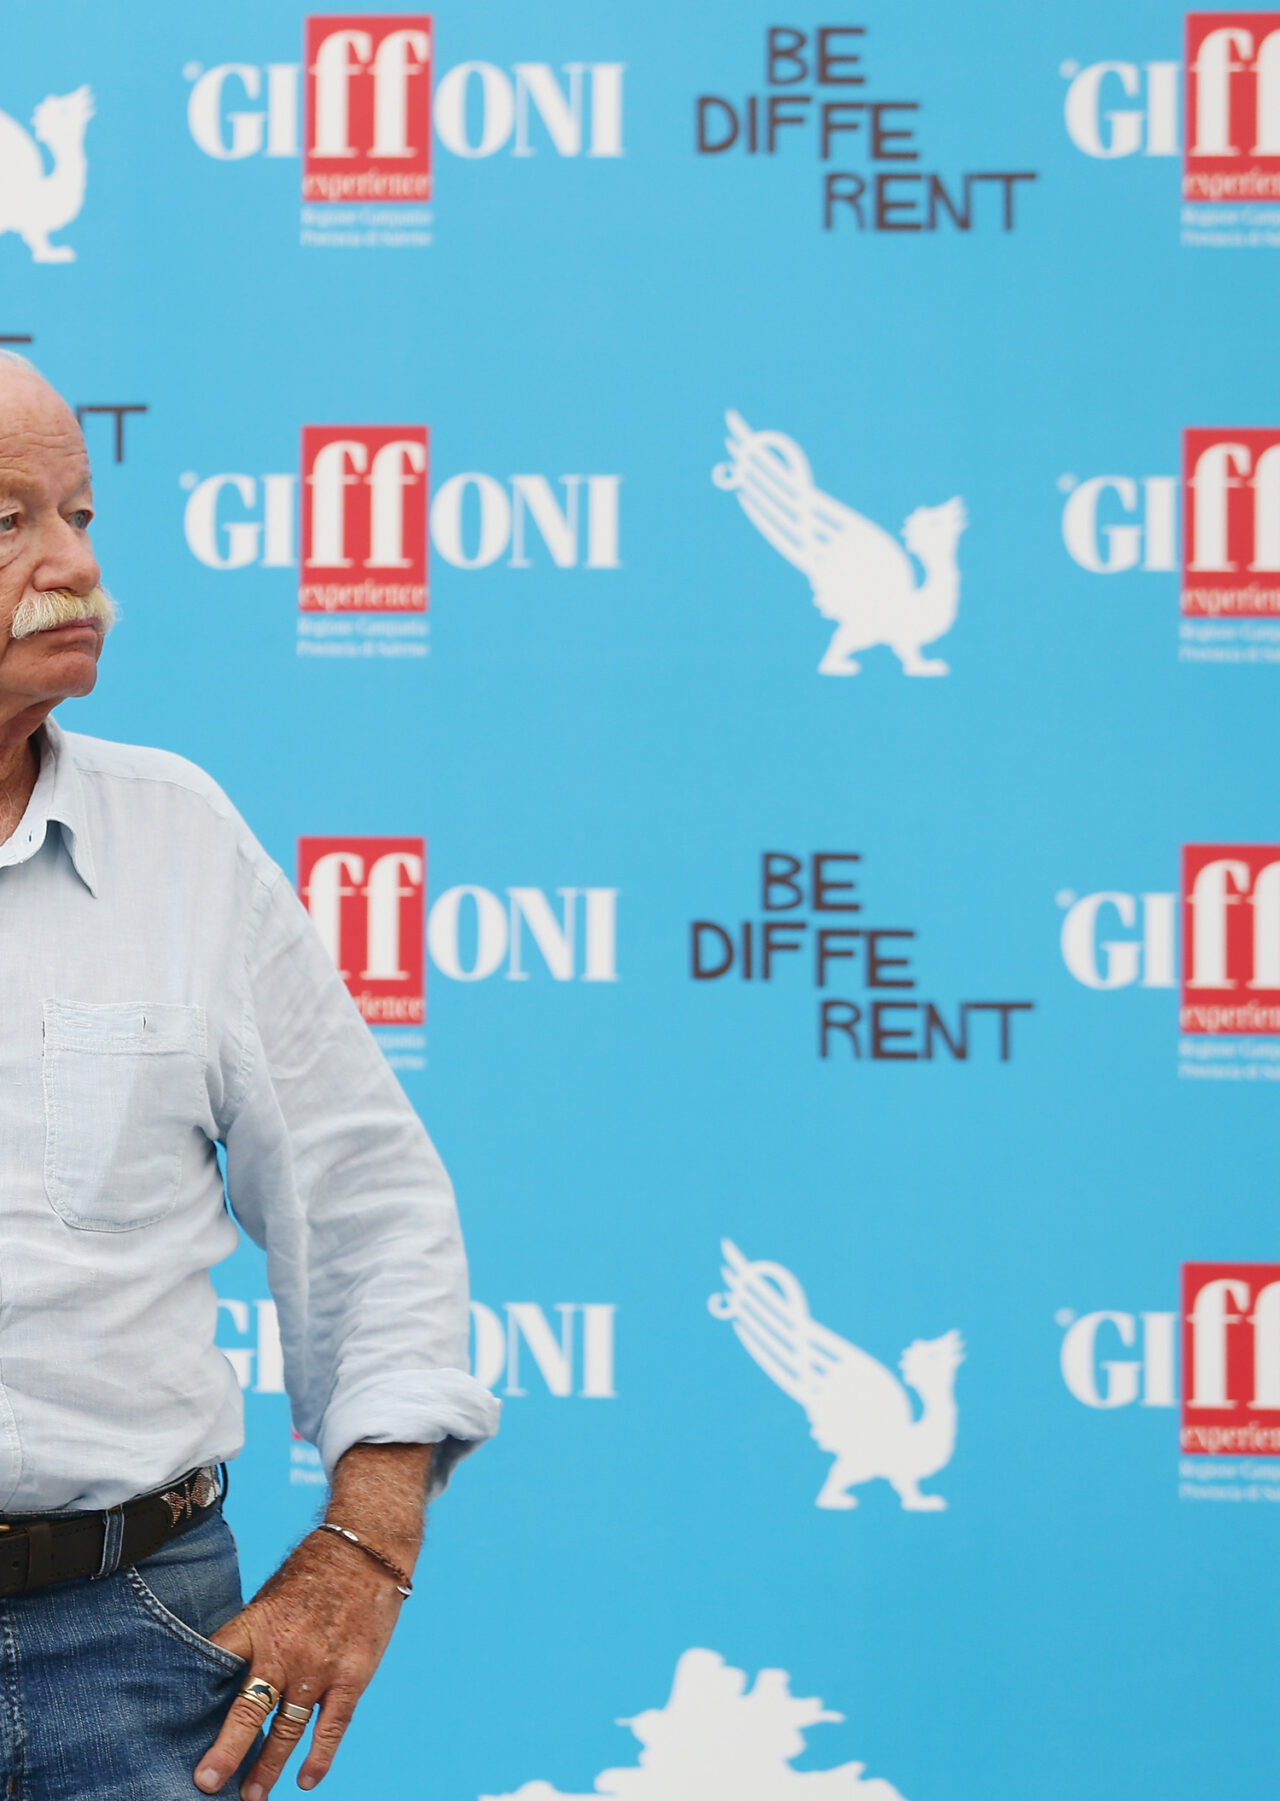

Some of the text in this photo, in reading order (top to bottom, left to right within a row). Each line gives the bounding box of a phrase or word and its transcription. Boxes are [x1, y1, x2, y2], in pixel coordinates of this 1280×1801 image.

[768, 27, 866, 86] BE
[697, 96, 920, 161] DIFFE
[301, 166, 431, 203] experience
[825, 172, 1038, 232] RENT
[298, 577, 429, 613] experience
[763, 852, 861, 912] BE
[691, 921, 915, 988] DIFFE
[821, 1000, 1035, 1061] RENT
